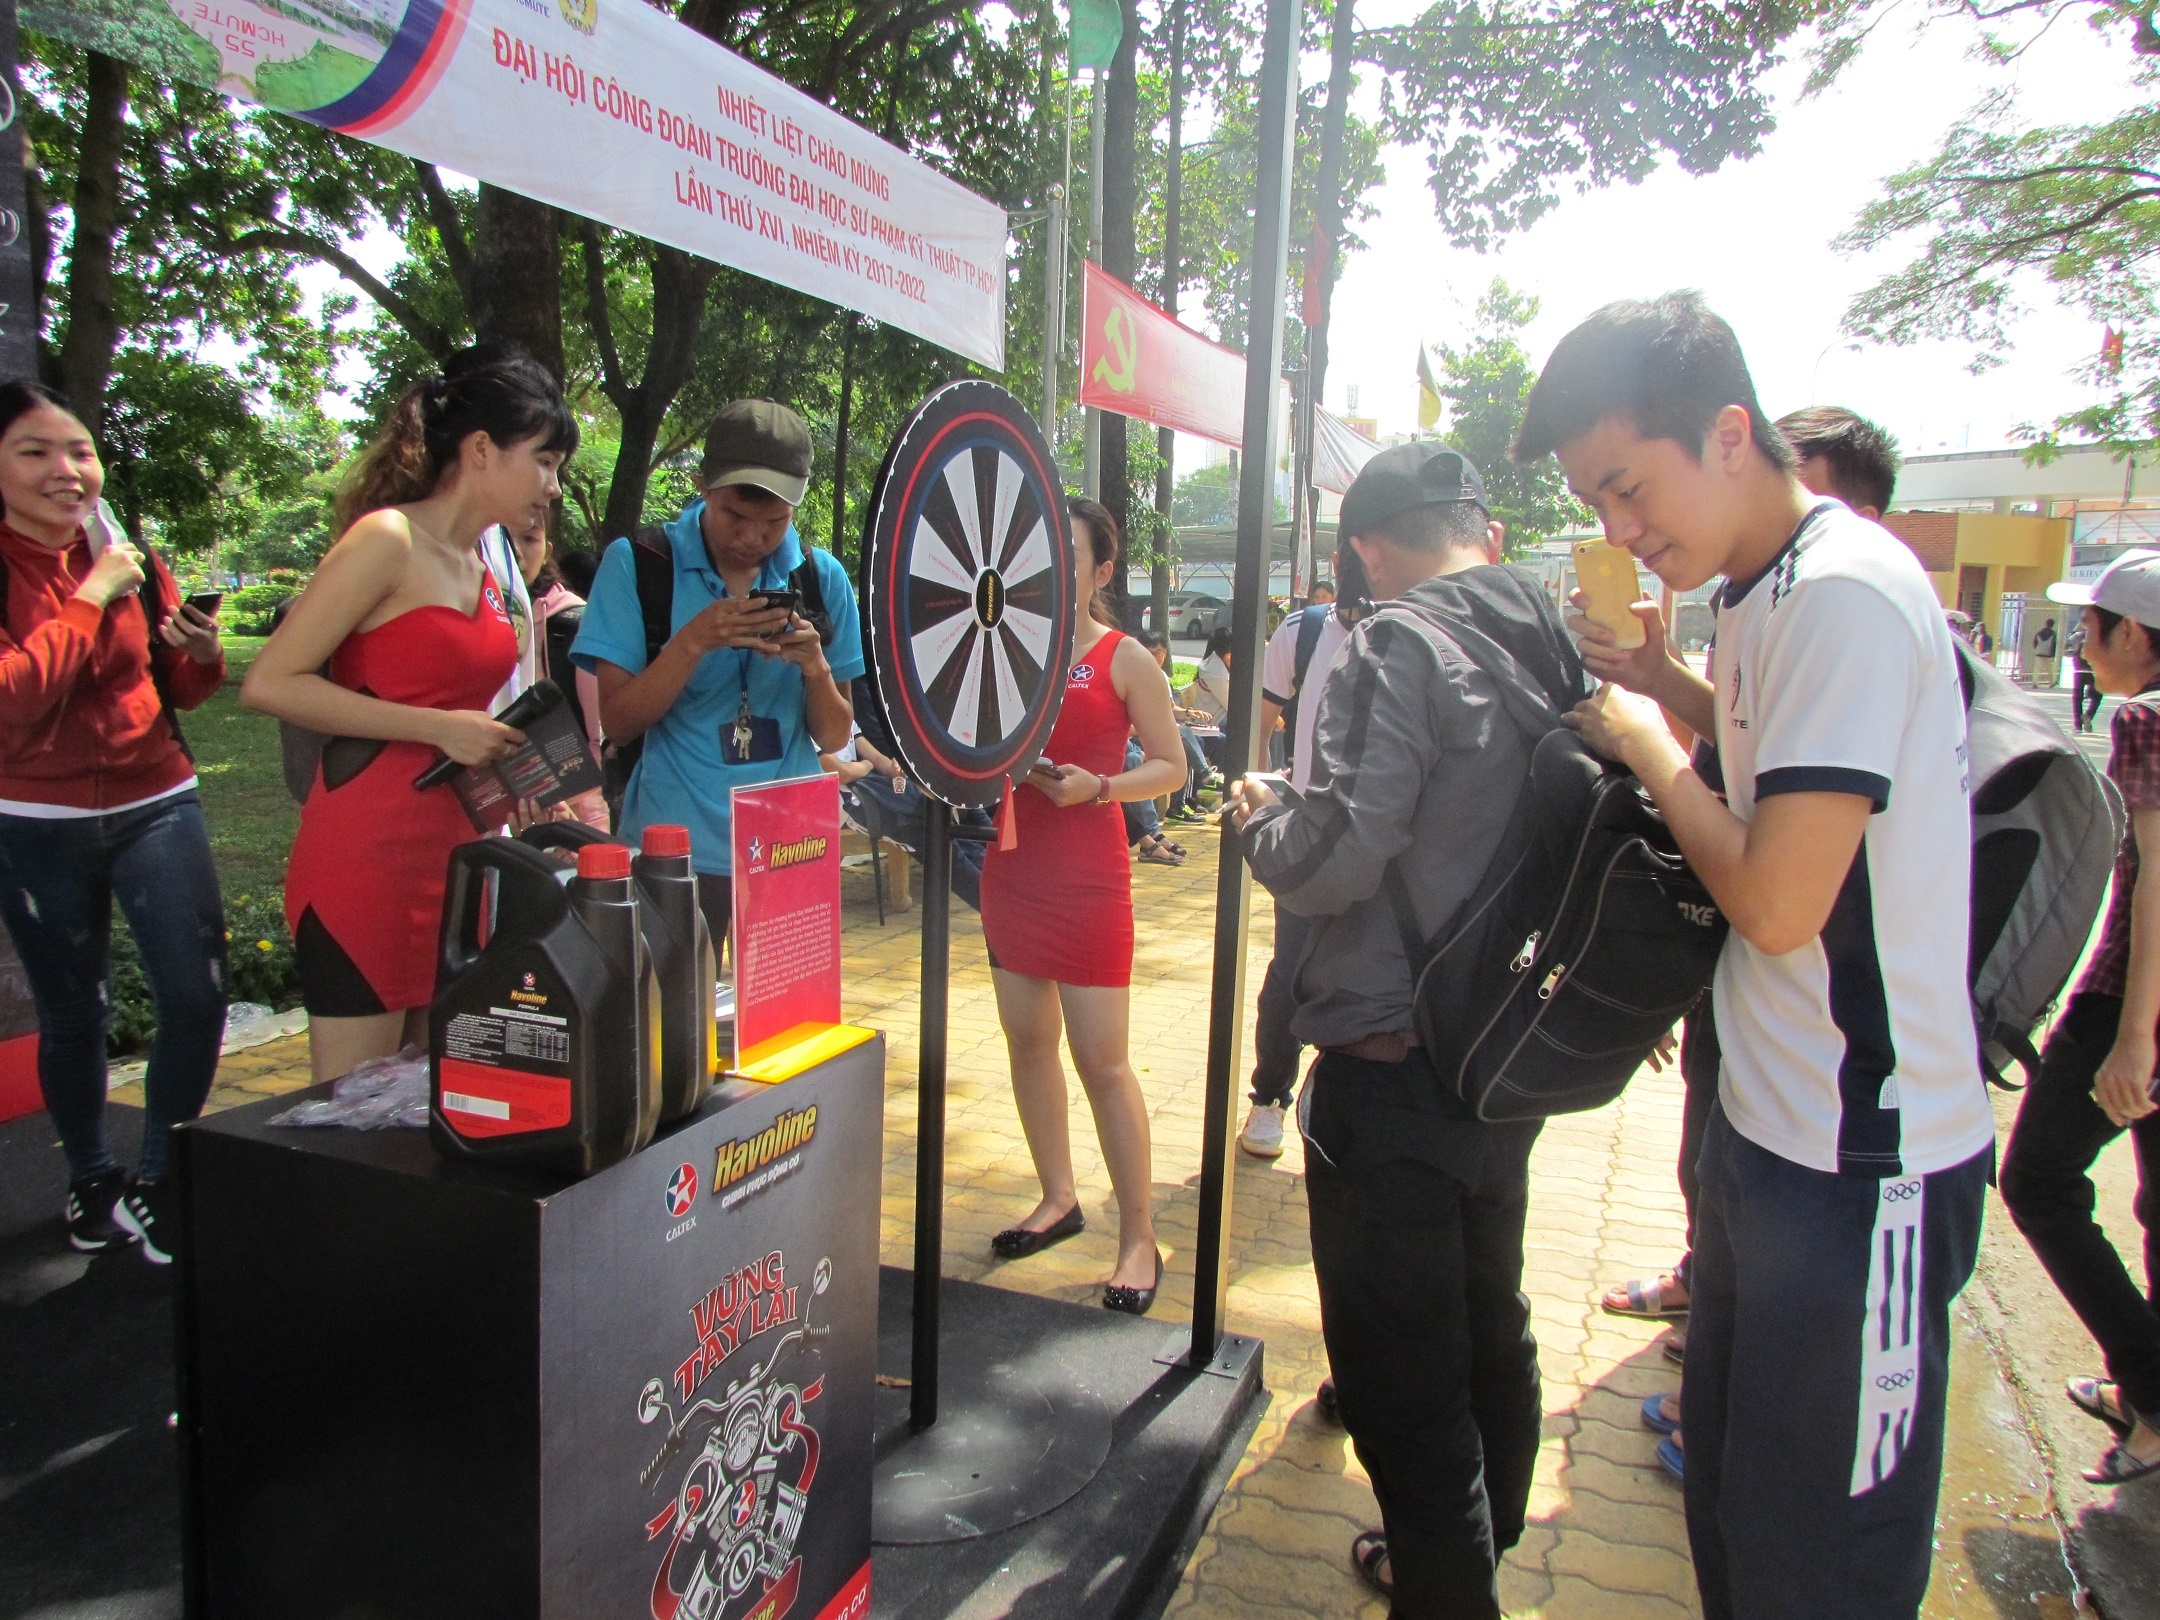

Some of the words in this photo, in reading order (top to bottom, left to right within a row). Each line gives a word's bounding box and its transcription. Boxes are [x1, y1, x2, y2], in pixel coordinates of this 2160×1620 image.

[193, 1, 286, 48] HCMUTE
[492, 27, 537, 84] ĐẠI
[543, 51, 586, 107] HỘI
[592, 75, 653, 134] CÔNG
[657, 107, 712, 161] ĐOÀN
[715, 135, 786, 198] TRƯỜNG
[789, 173, 815, 215] ĐẠI
[818, 187, 847, 228] HỌC
[850, 203, 869, 236] SƯ
[871, 214, 907, 255] PHẠM
[907, 232, 924, 263] KỸ
[925, 242, 962, 283] THUẬT
[718, 85, 767, 139] NHIỆT
[771, 114, 804, 159] LIỆT
[808, 134, 847, 179] CHÀO
[850, 158, 890, 202] MỪNG
[674, 164, 714, 216] LẦN
[715, 188, 753, 232] THỨ
[756, 206, 790, 252] XVI,
[791, 222, 842, 268] NHIỆM
[842, 242, 861, 276] KỲ
[863, 254, 927, 304] 2017-2022
[769, 836, 828, 869] Havoline
[510, 989, 548, 1005] Havoline
[712, 1104, 818, 1194] Havoline
[665, 1215, 698, 1243] CALTEX
[688, 1249, 787, 1344] VỮNG
[673, 1297, 754, 1406] TAY
[748, 1281, 800, 1340] LÁI
[731, 1519, 755, 1545] CALTEX
